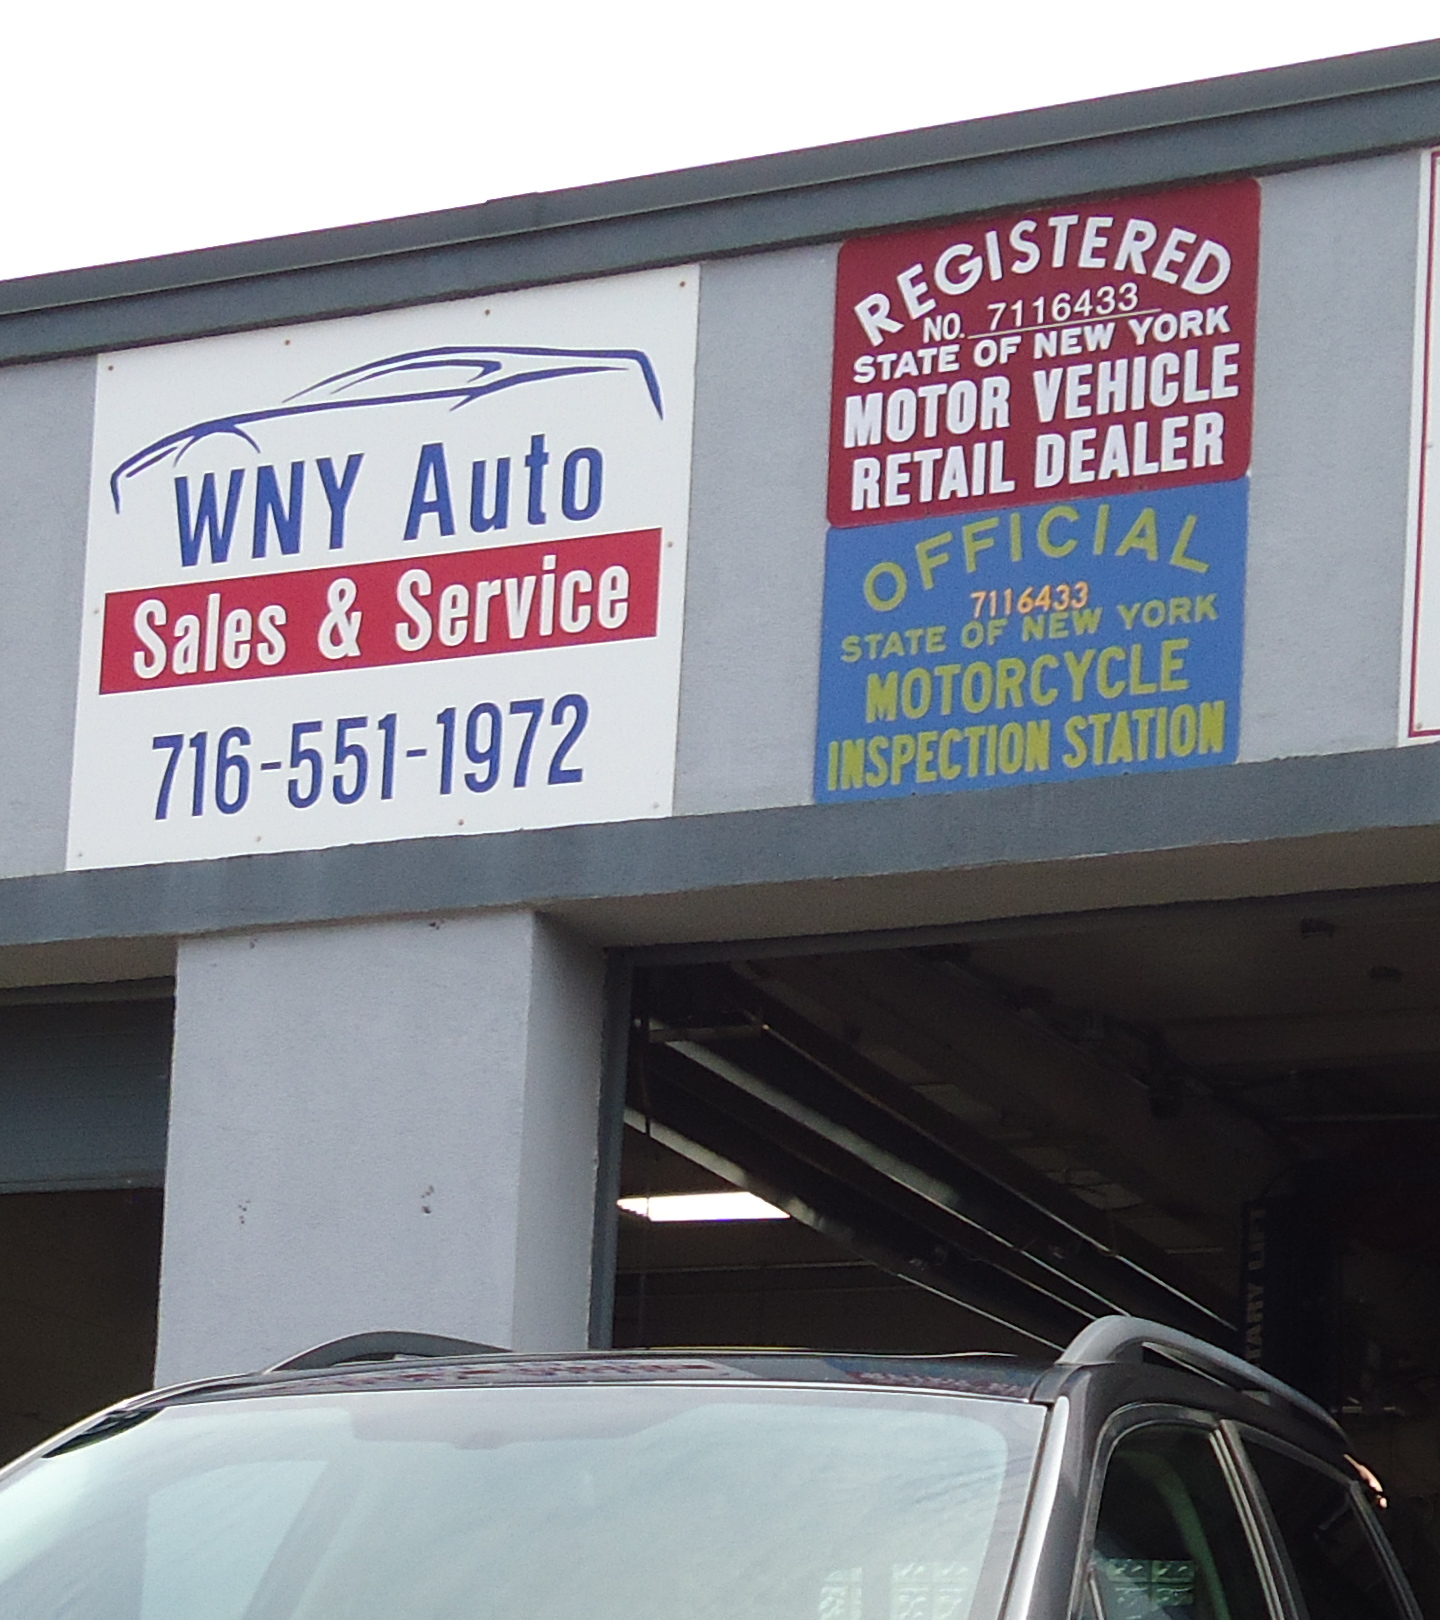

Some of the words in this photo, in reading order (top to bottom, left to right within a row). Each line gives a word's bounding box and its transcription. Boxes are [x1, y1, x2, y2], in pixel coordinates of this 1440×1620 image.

[854, 214, 1232, 346] REGISTERED
[987, 282, 1139, 331] 7116433
[853, 344, 960, 383] STATE
[973, 336, 1022, 368] OF
[1033, 322, 1115, 359] NEW
[1128, 305, 1231, 346] YORK
[843, 375, 1010, 448] MOTOR
[1032, 343, 1240, 422] VEHICLE
[174, 452, 365, 567] WNY
[403, 433, 603, 541] Auto
[850, 440, 1016, 511] RETAIL
[1034, 411, 1225, 489] DEALER
[862, 503, 1210, 612] OFFICIAL
[970, 581, 1089, 618] 7116433
[132, 593, 288, 680] Sales
[317, 577, 363, 660] &
[394, 554, 630, 654] Service
[840, 625, 947, 663] STATE
[961, 617, 1009, 649] OF
[1022, 606, 1103, 642] NEW
[1117, 593, 1219, 630] YORK
[866, 638, 1190, 723] MOTORCYCLE
[151, 693, 590, 821] 716-551-1972
[827, 719, 1051, 792] INSPECTION
[1062, 700, 1227, 768] STATION
